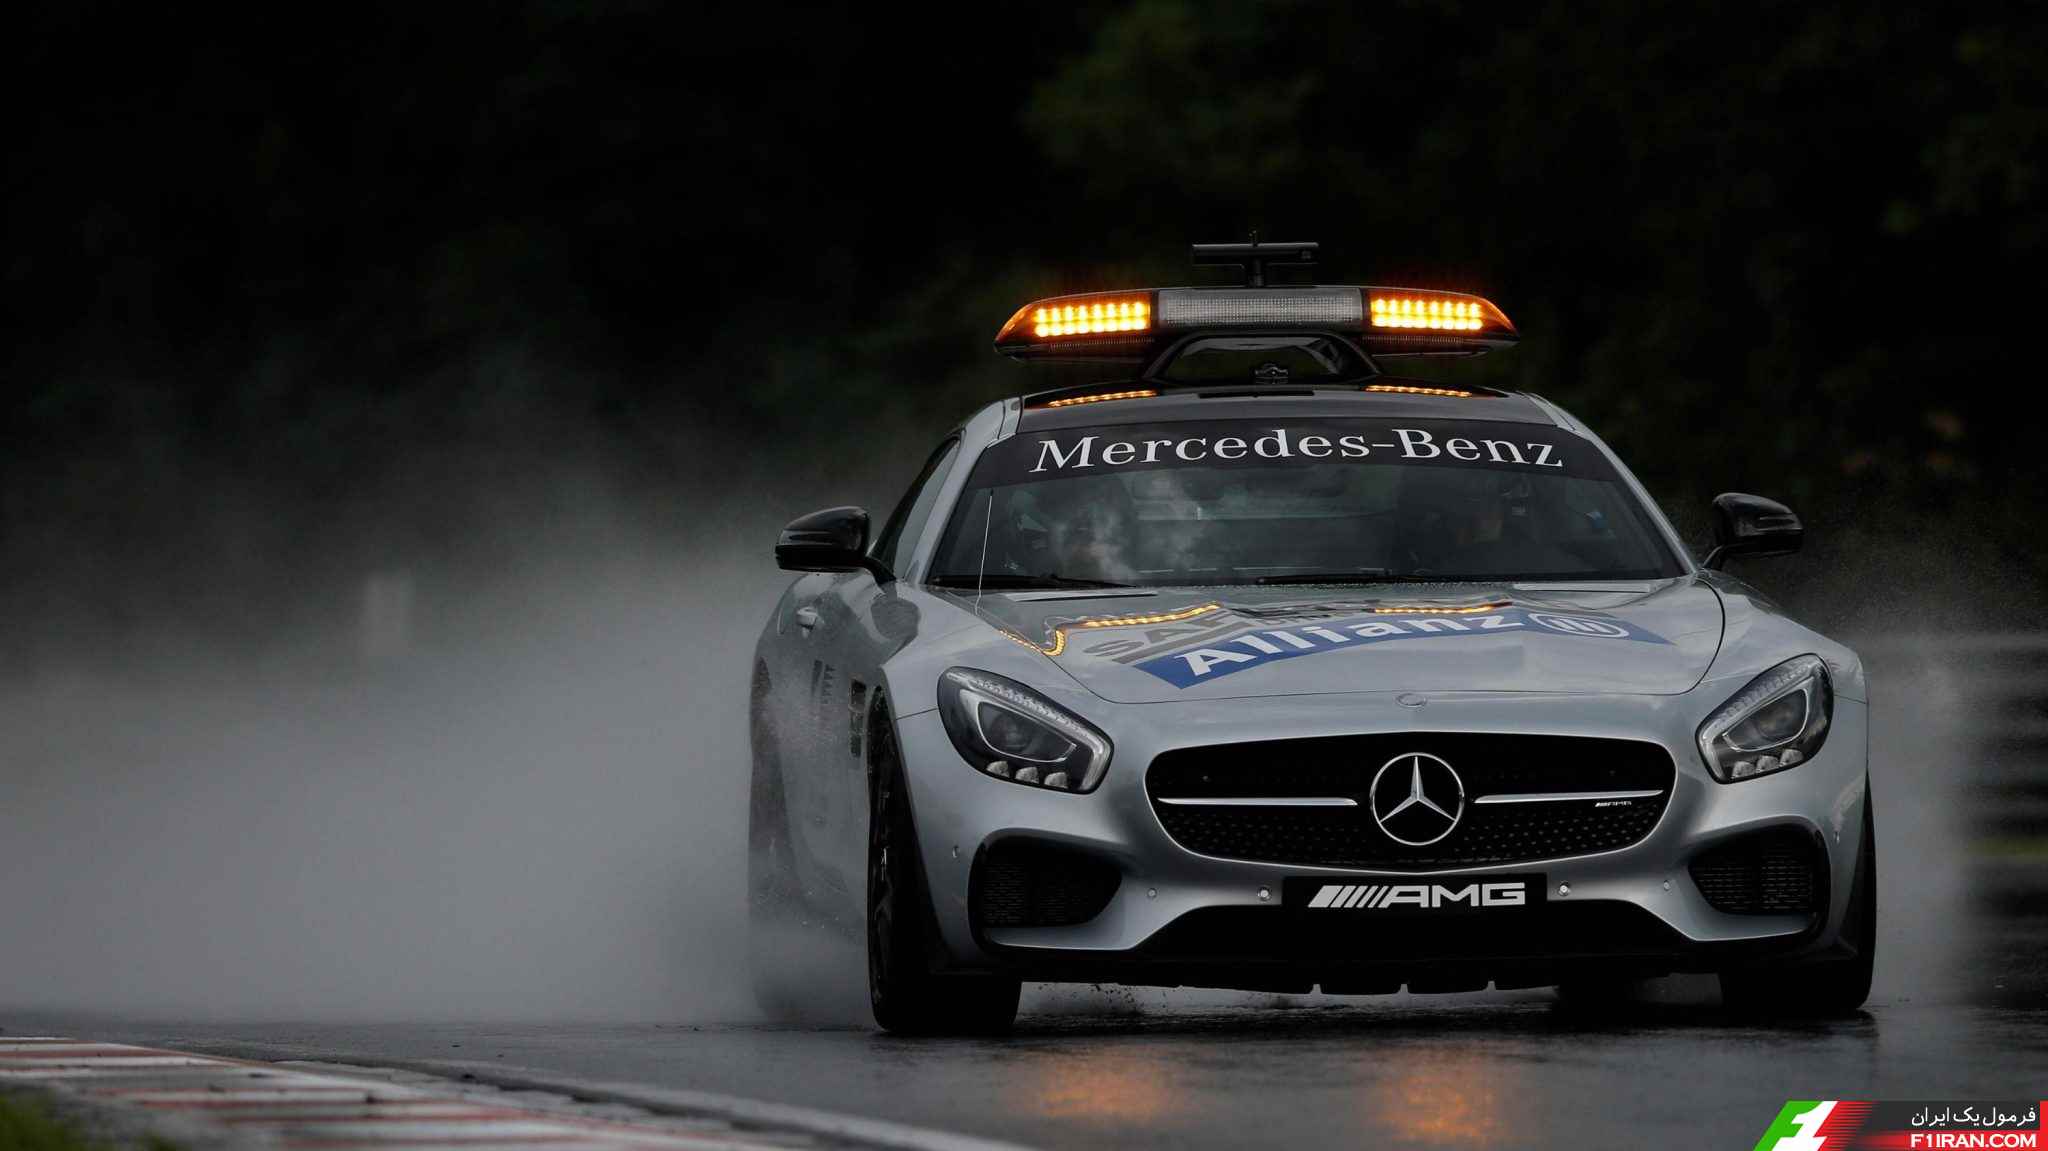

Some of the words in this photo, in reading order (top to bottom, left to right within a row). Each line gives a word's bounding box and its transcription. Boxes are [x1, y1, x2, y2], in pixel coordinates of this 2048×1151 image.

[1028, 427, 1564, 473] Mercedes-Benz
[1173, 613, 1525, 676] Allianz
[1381, 882, 1526, 908] AMG
